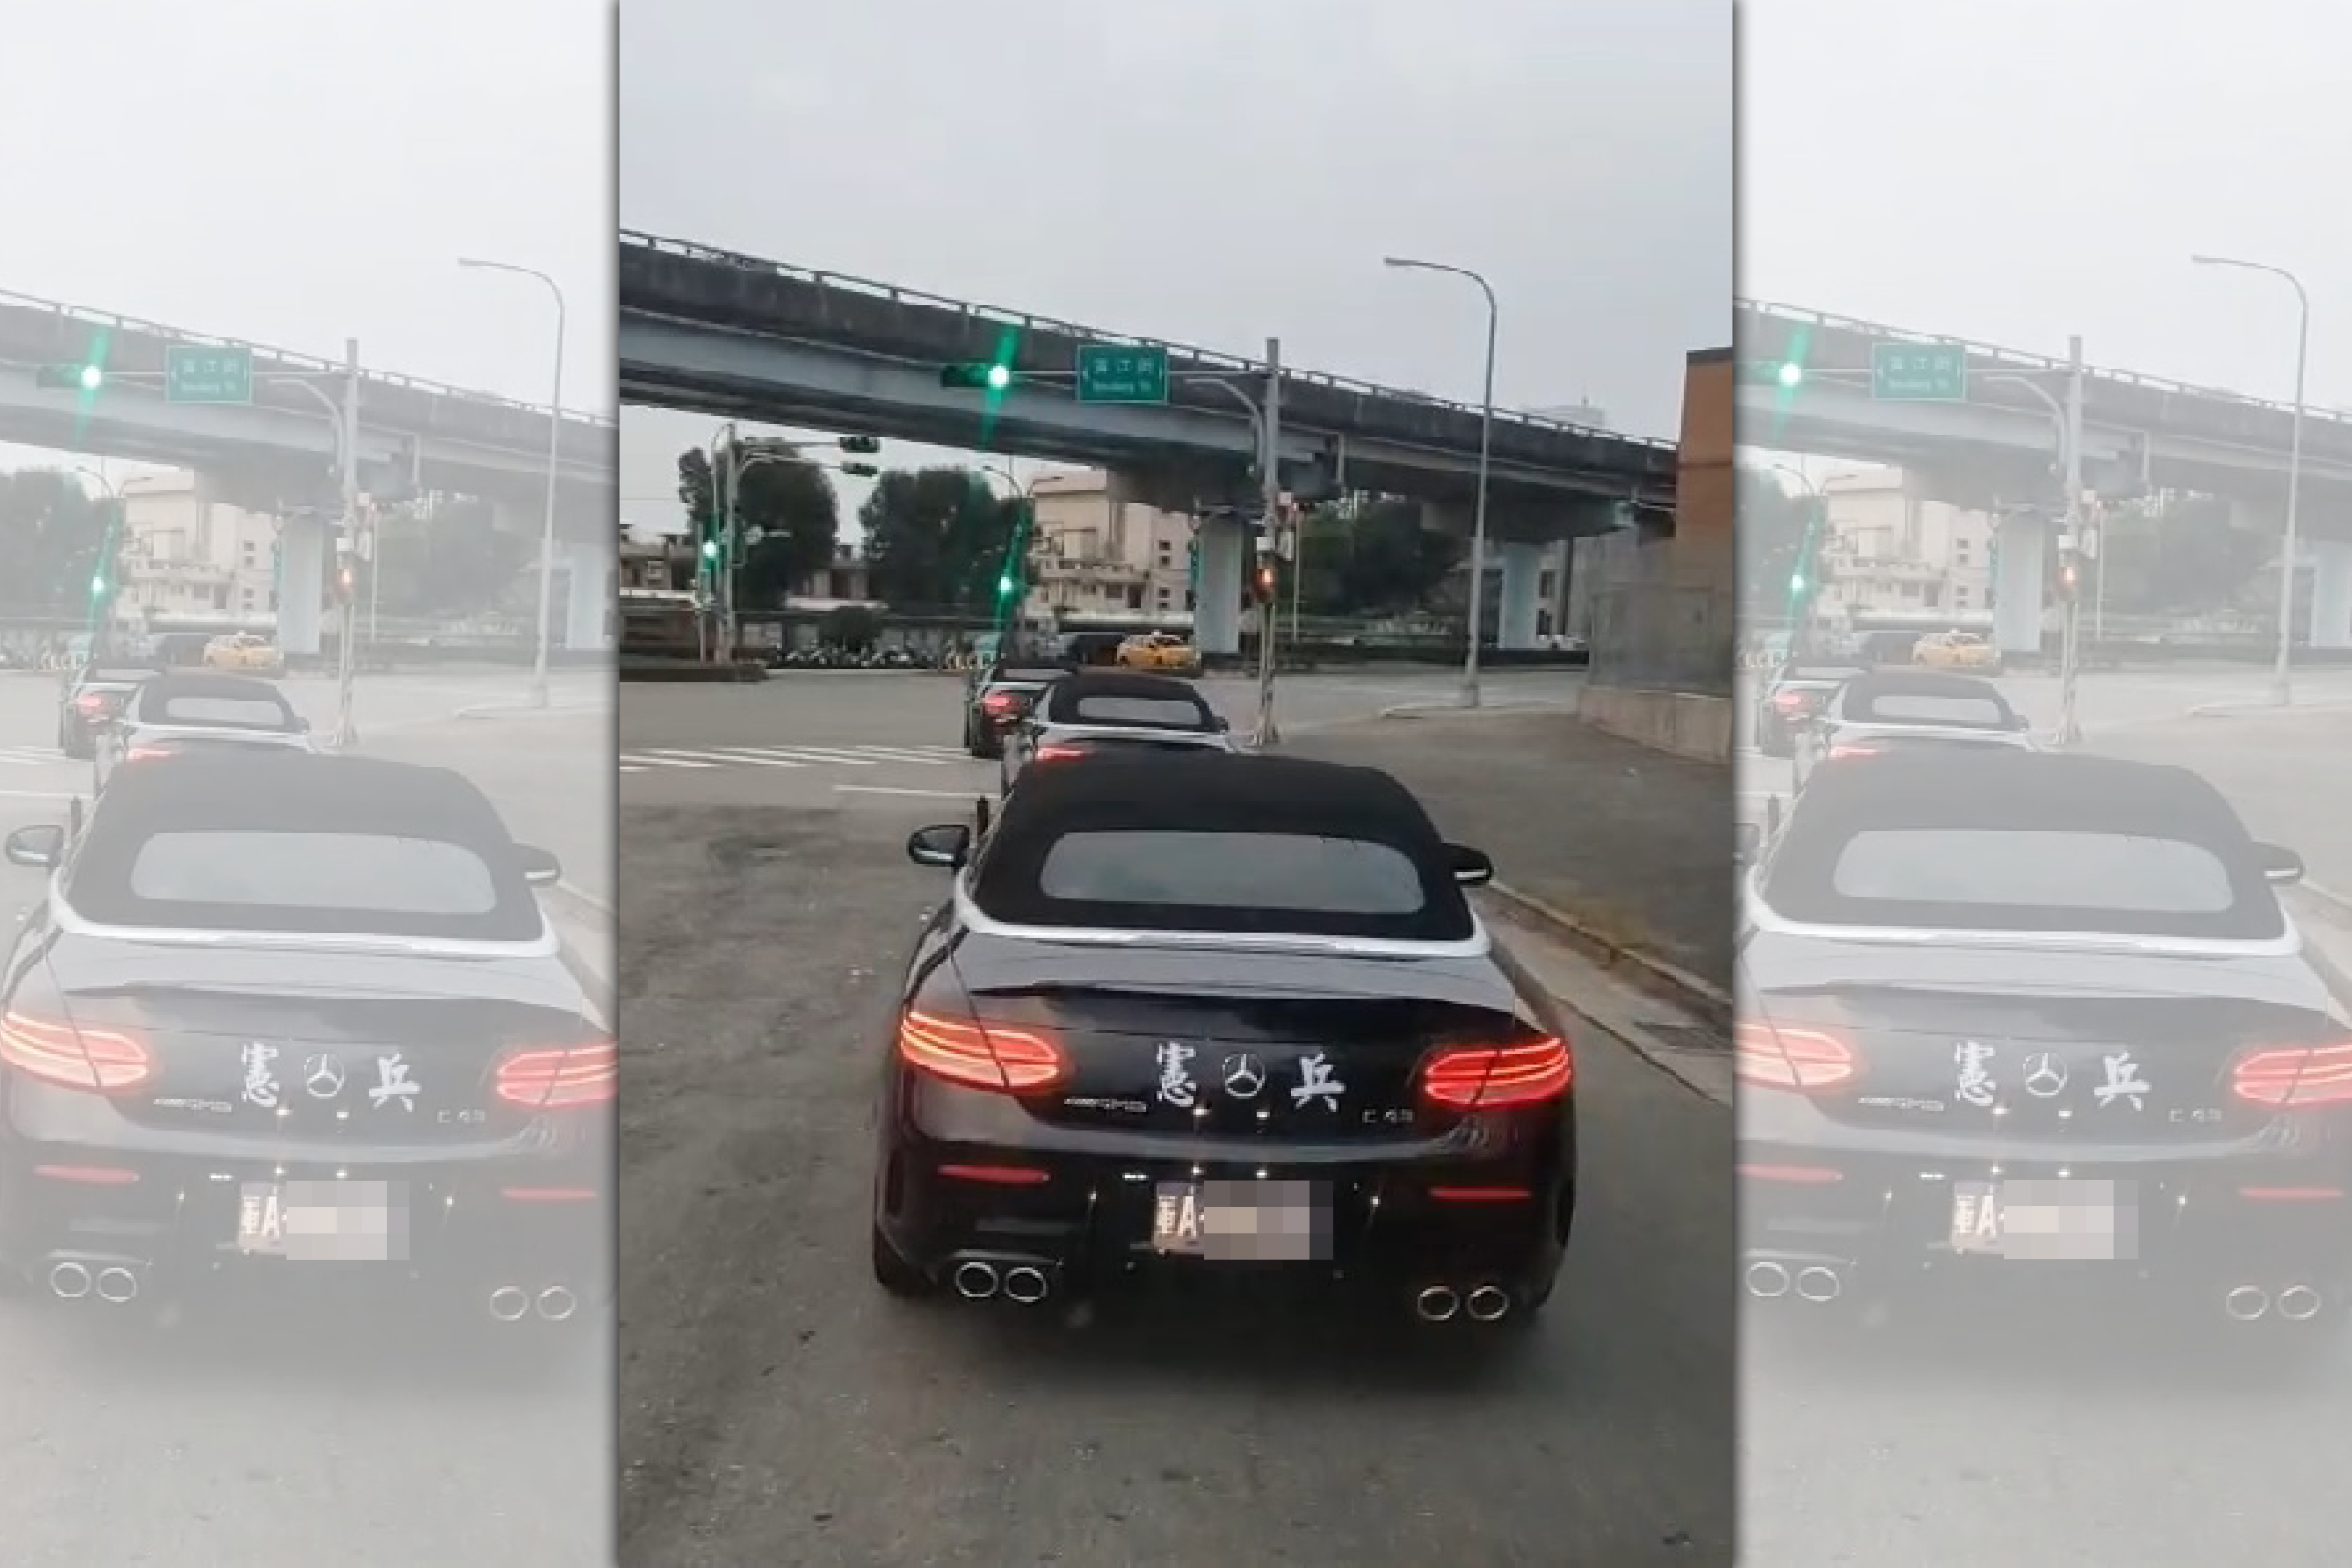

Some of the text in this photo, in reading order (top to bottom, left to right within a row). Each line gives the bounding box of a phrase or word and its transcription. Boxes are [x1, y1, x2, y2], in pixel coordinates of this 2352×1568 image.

[241, 1041, 420, 1113] 憲 兵
[1156, 1041, 1346, 1112] 憲 兵
[1954, 1040, 2150, 1112] 憲 兵
